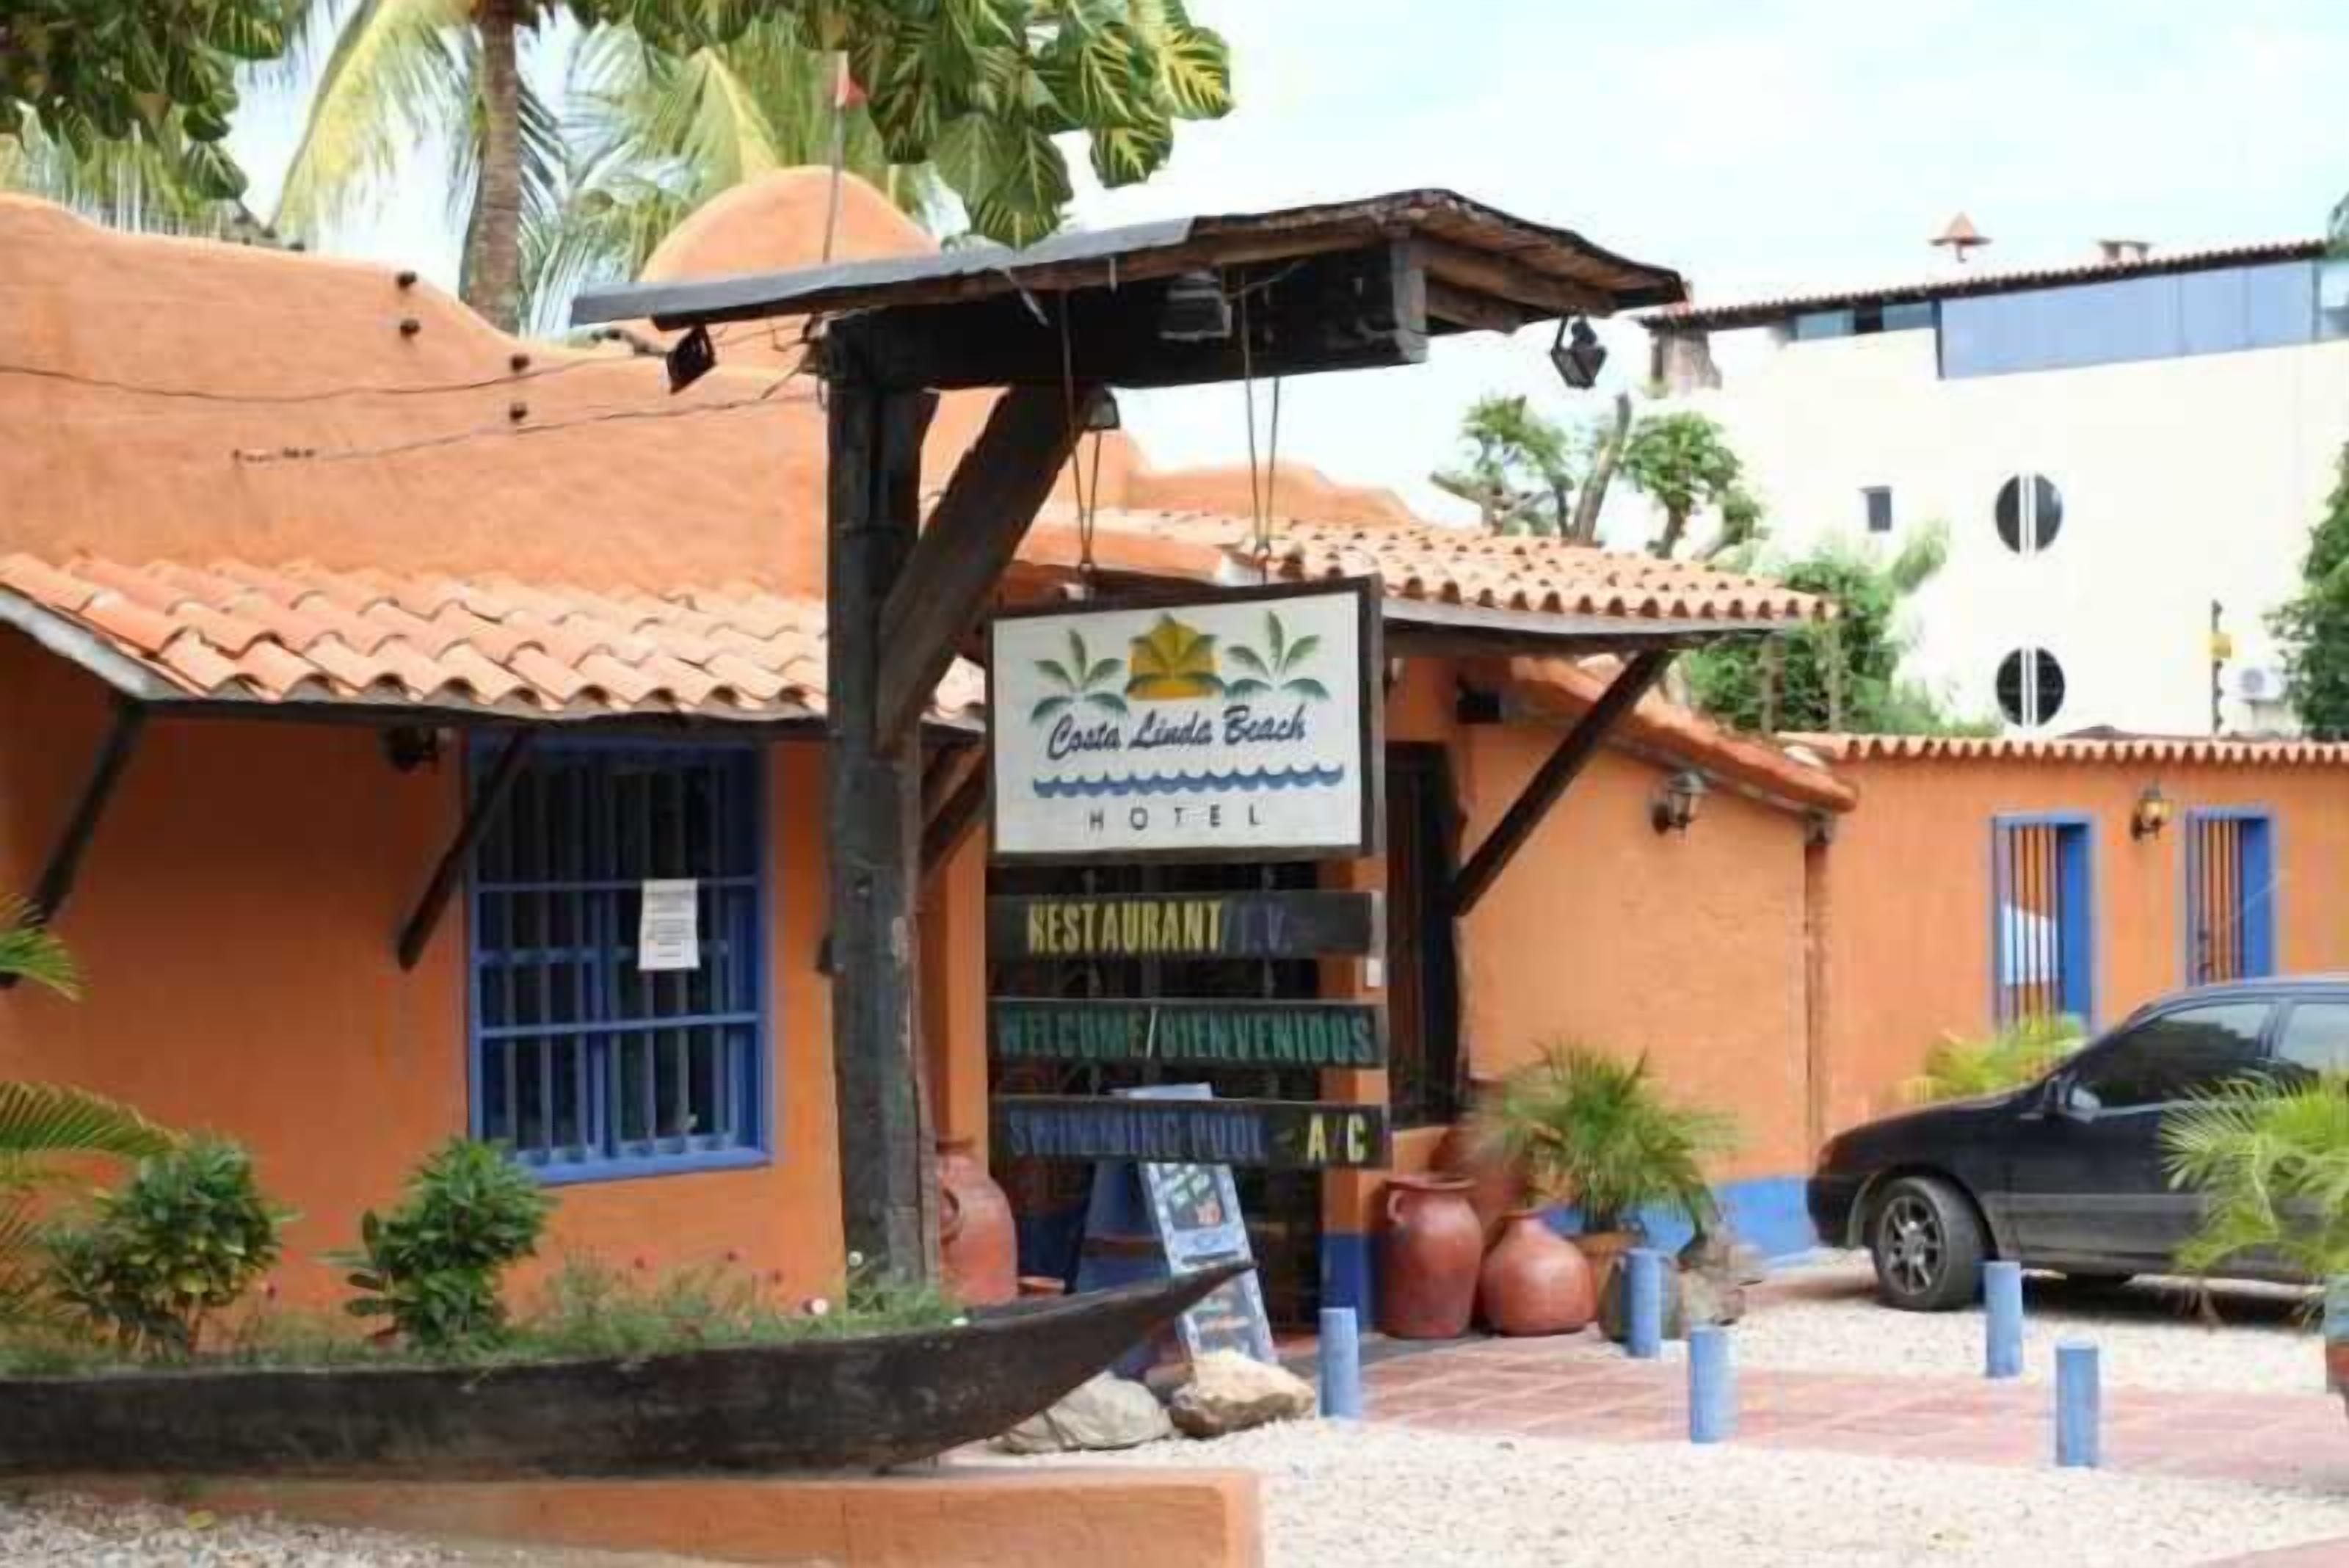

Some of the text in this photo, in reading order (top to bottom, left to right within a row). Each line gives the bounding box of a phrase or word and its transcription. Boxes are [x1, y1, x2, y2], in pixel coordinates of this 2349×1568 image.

[1047, 703, 1306, 761] Costa Linda Beach
[1088, 804, 1261, 832] HOTEL
